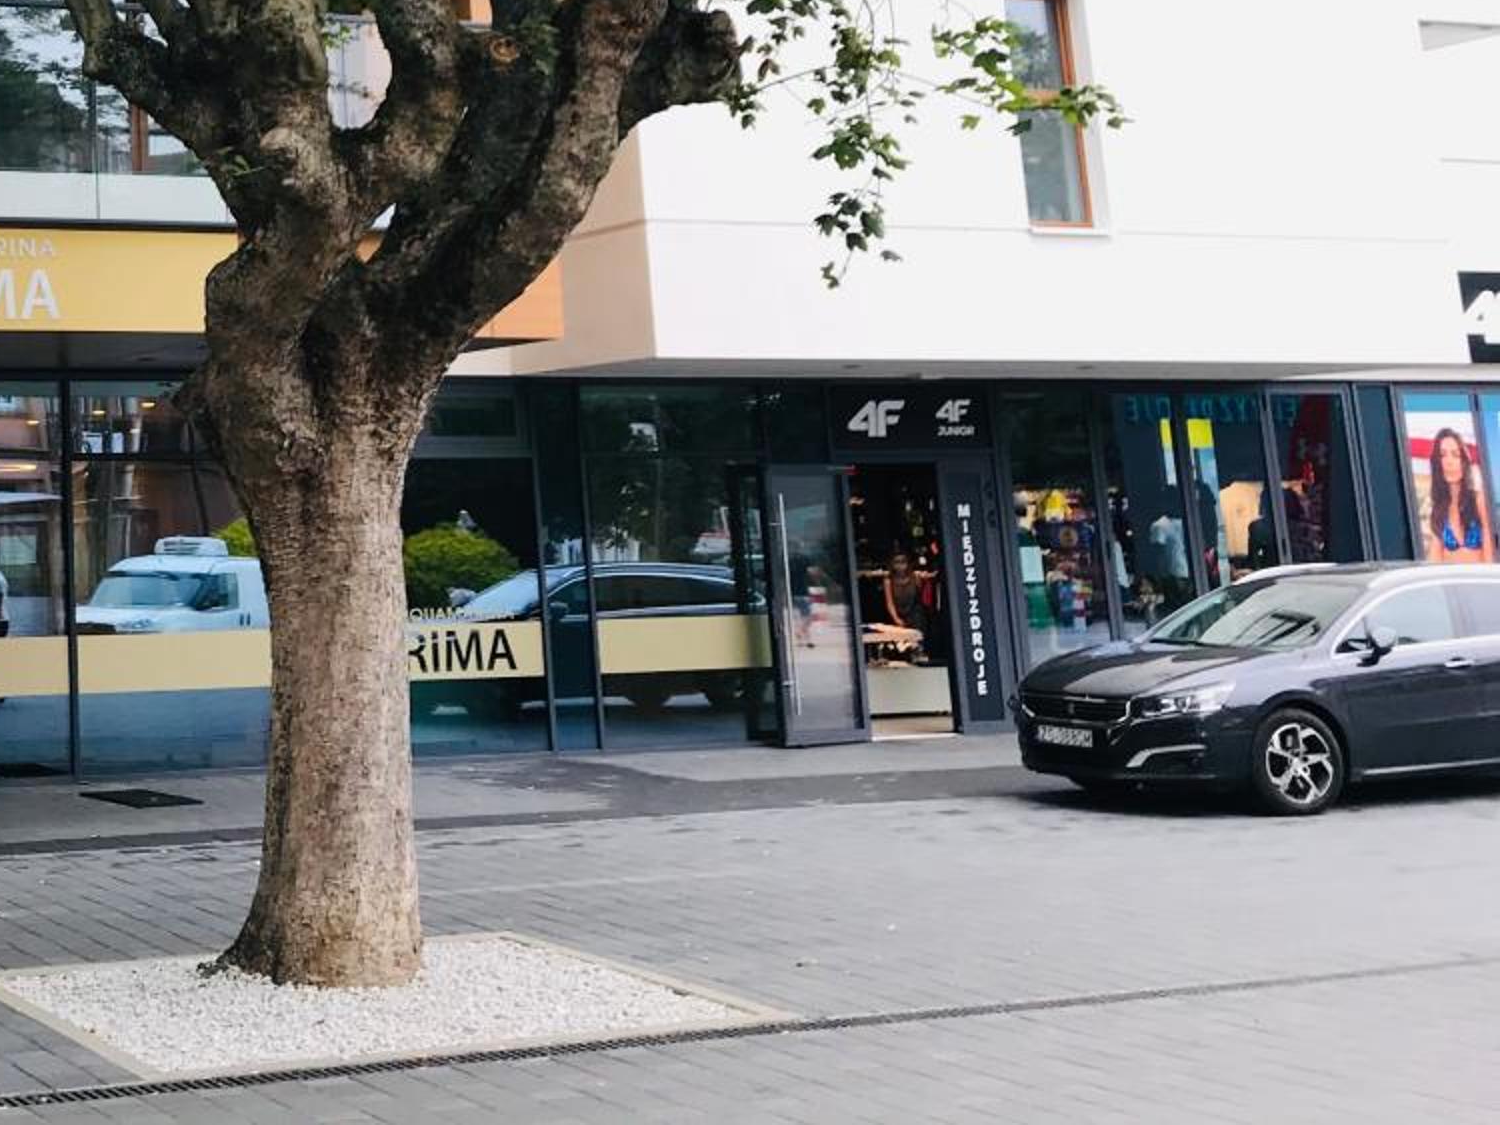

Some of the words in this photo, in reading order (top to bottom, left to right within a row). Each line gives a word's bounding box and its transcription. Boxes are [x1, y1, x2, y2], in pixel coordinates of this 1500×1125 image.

[847, 400, 905, 437] 4F
[935, 399, 971, 423] 4F
[937, 426, 975, 437] JUNIOR
